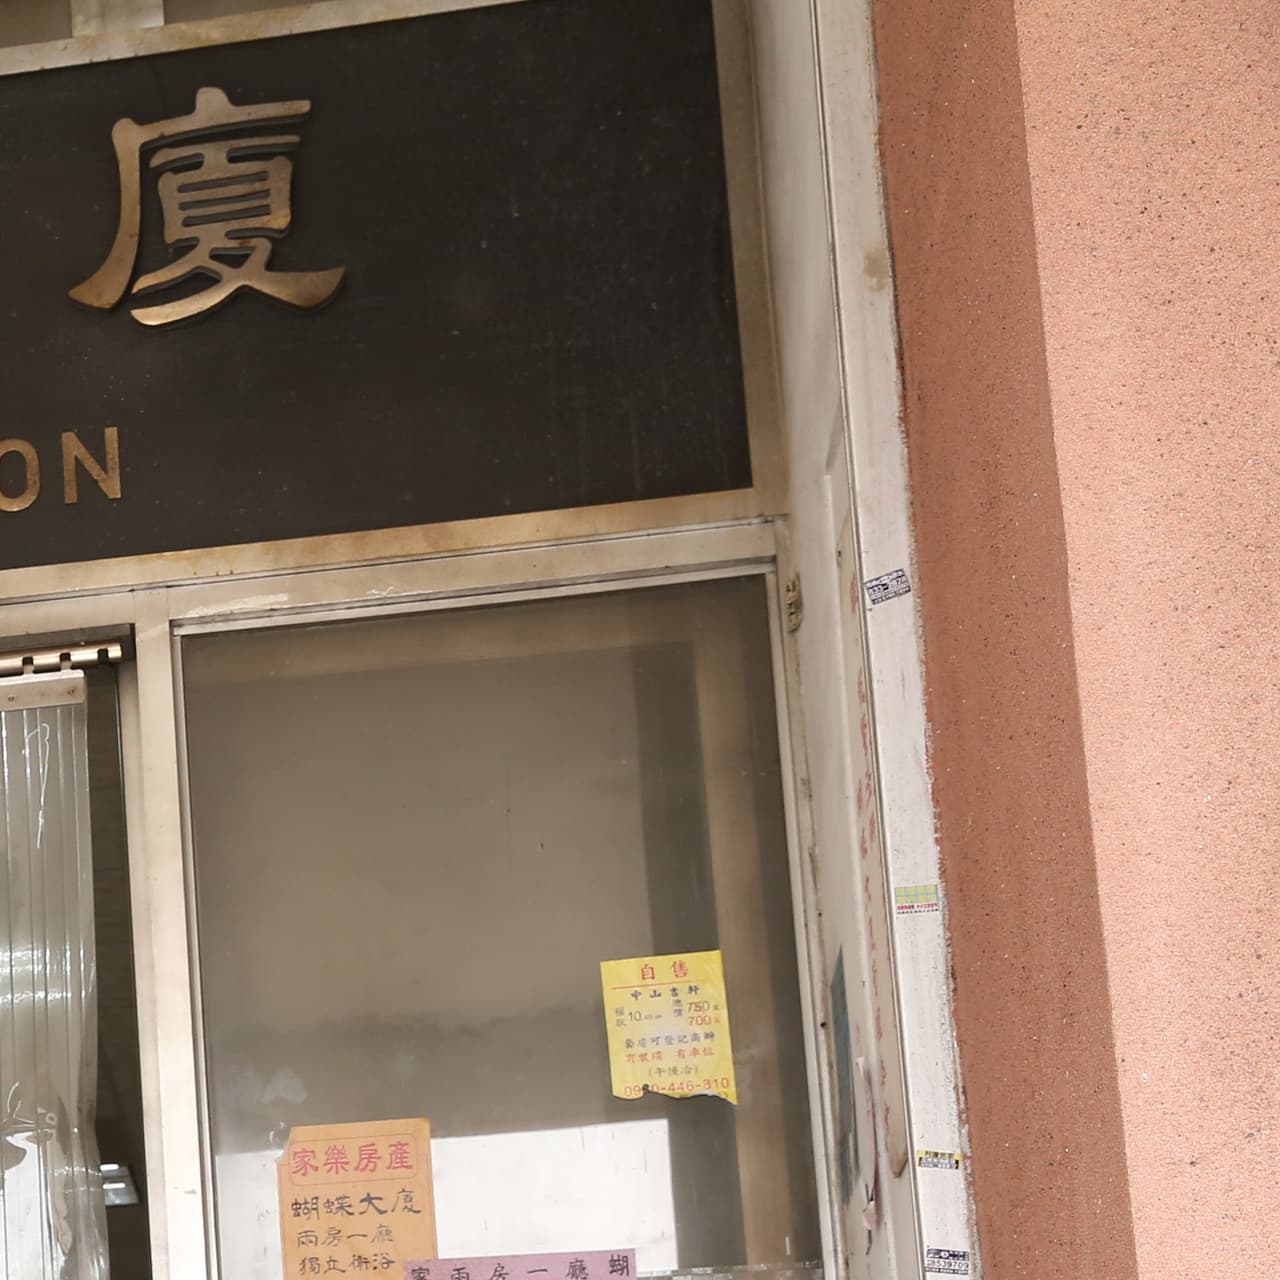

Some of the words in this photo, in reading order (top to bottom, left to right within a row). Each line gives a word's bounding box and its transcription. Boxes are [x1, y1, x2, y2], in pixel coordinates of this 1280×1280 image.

[292, 1140, 414, 1178] 家樂房產
[291, 1188, 423, 1221] 蝴蝶大廈
[297, 1224, 395, 1249] 兩房一廳
